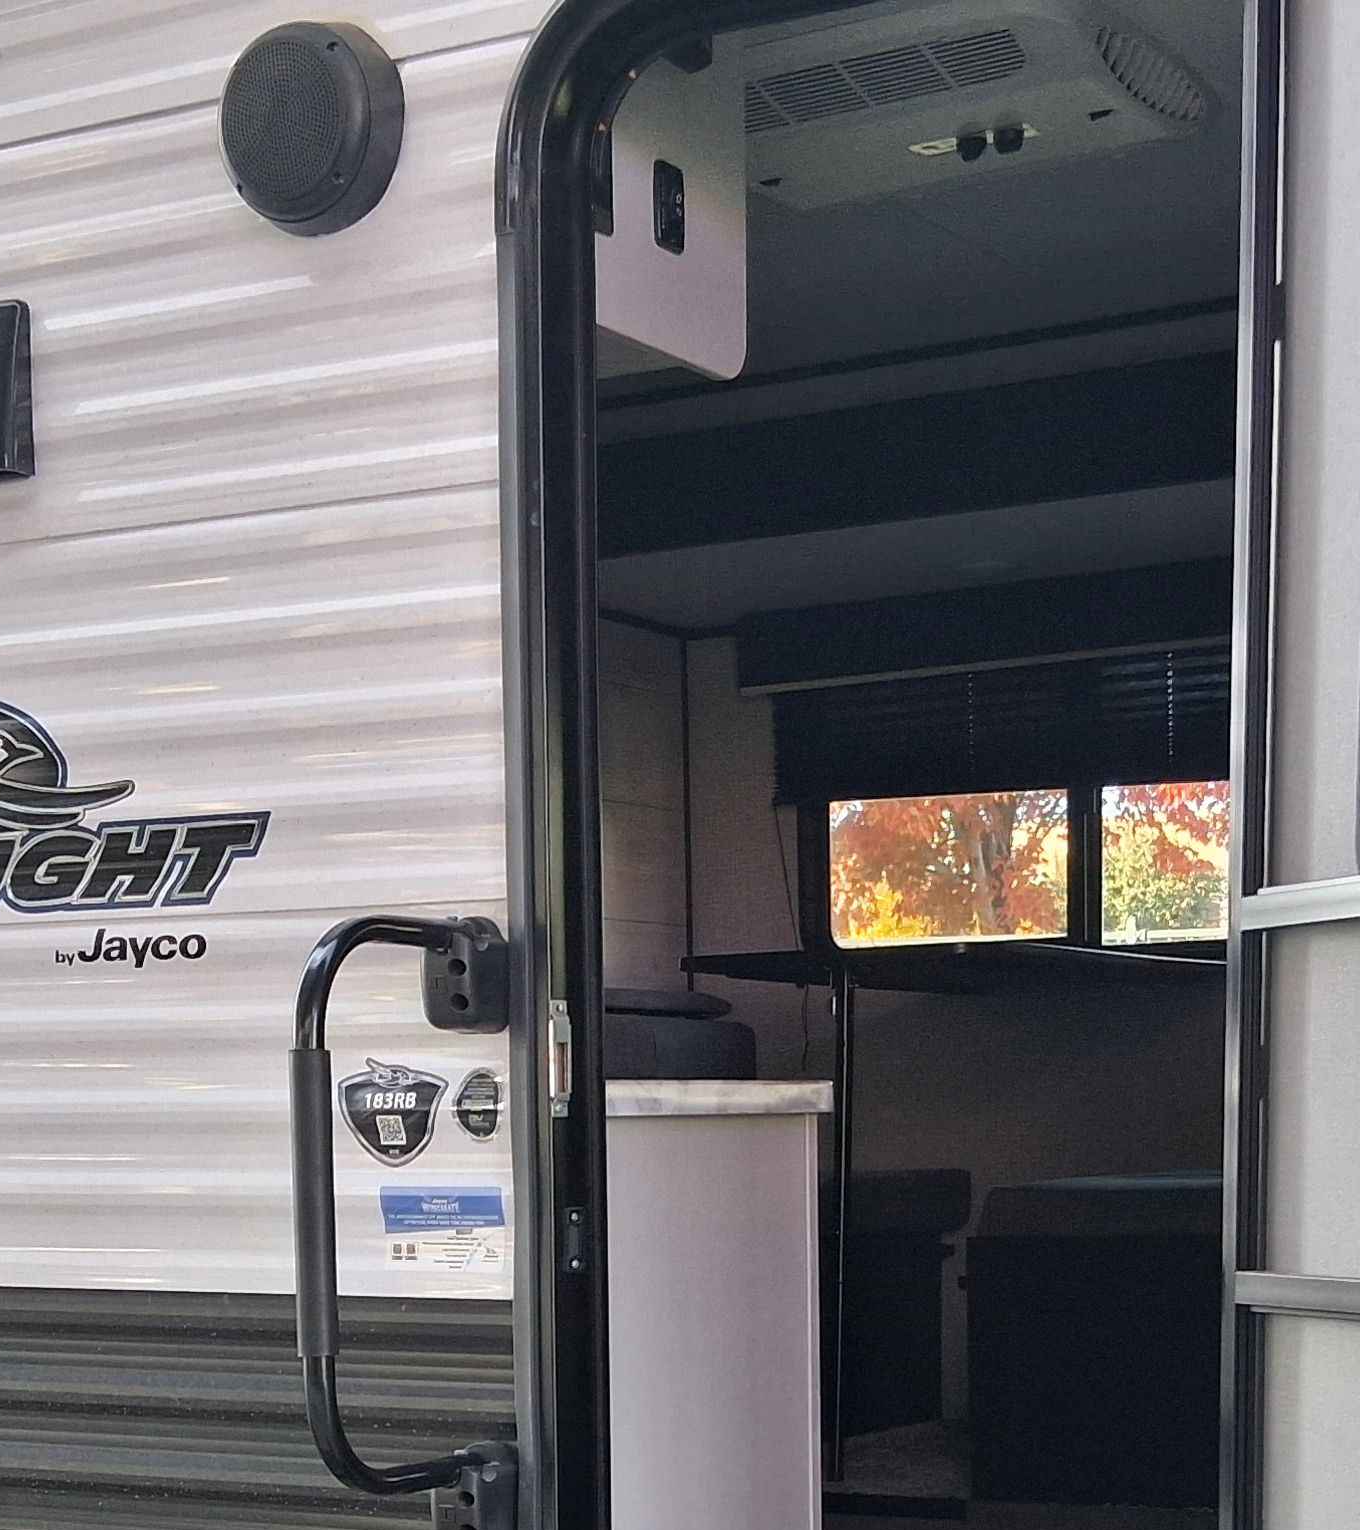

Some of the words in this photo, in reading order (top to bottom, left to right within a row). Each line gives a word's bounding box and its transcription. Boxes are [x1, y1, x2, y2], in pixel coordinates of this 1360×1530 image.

[55, 948, 76, 967] by
[77, 928, 208, 969] Jayco
[364, 1092, 417, 1109] 183RB
